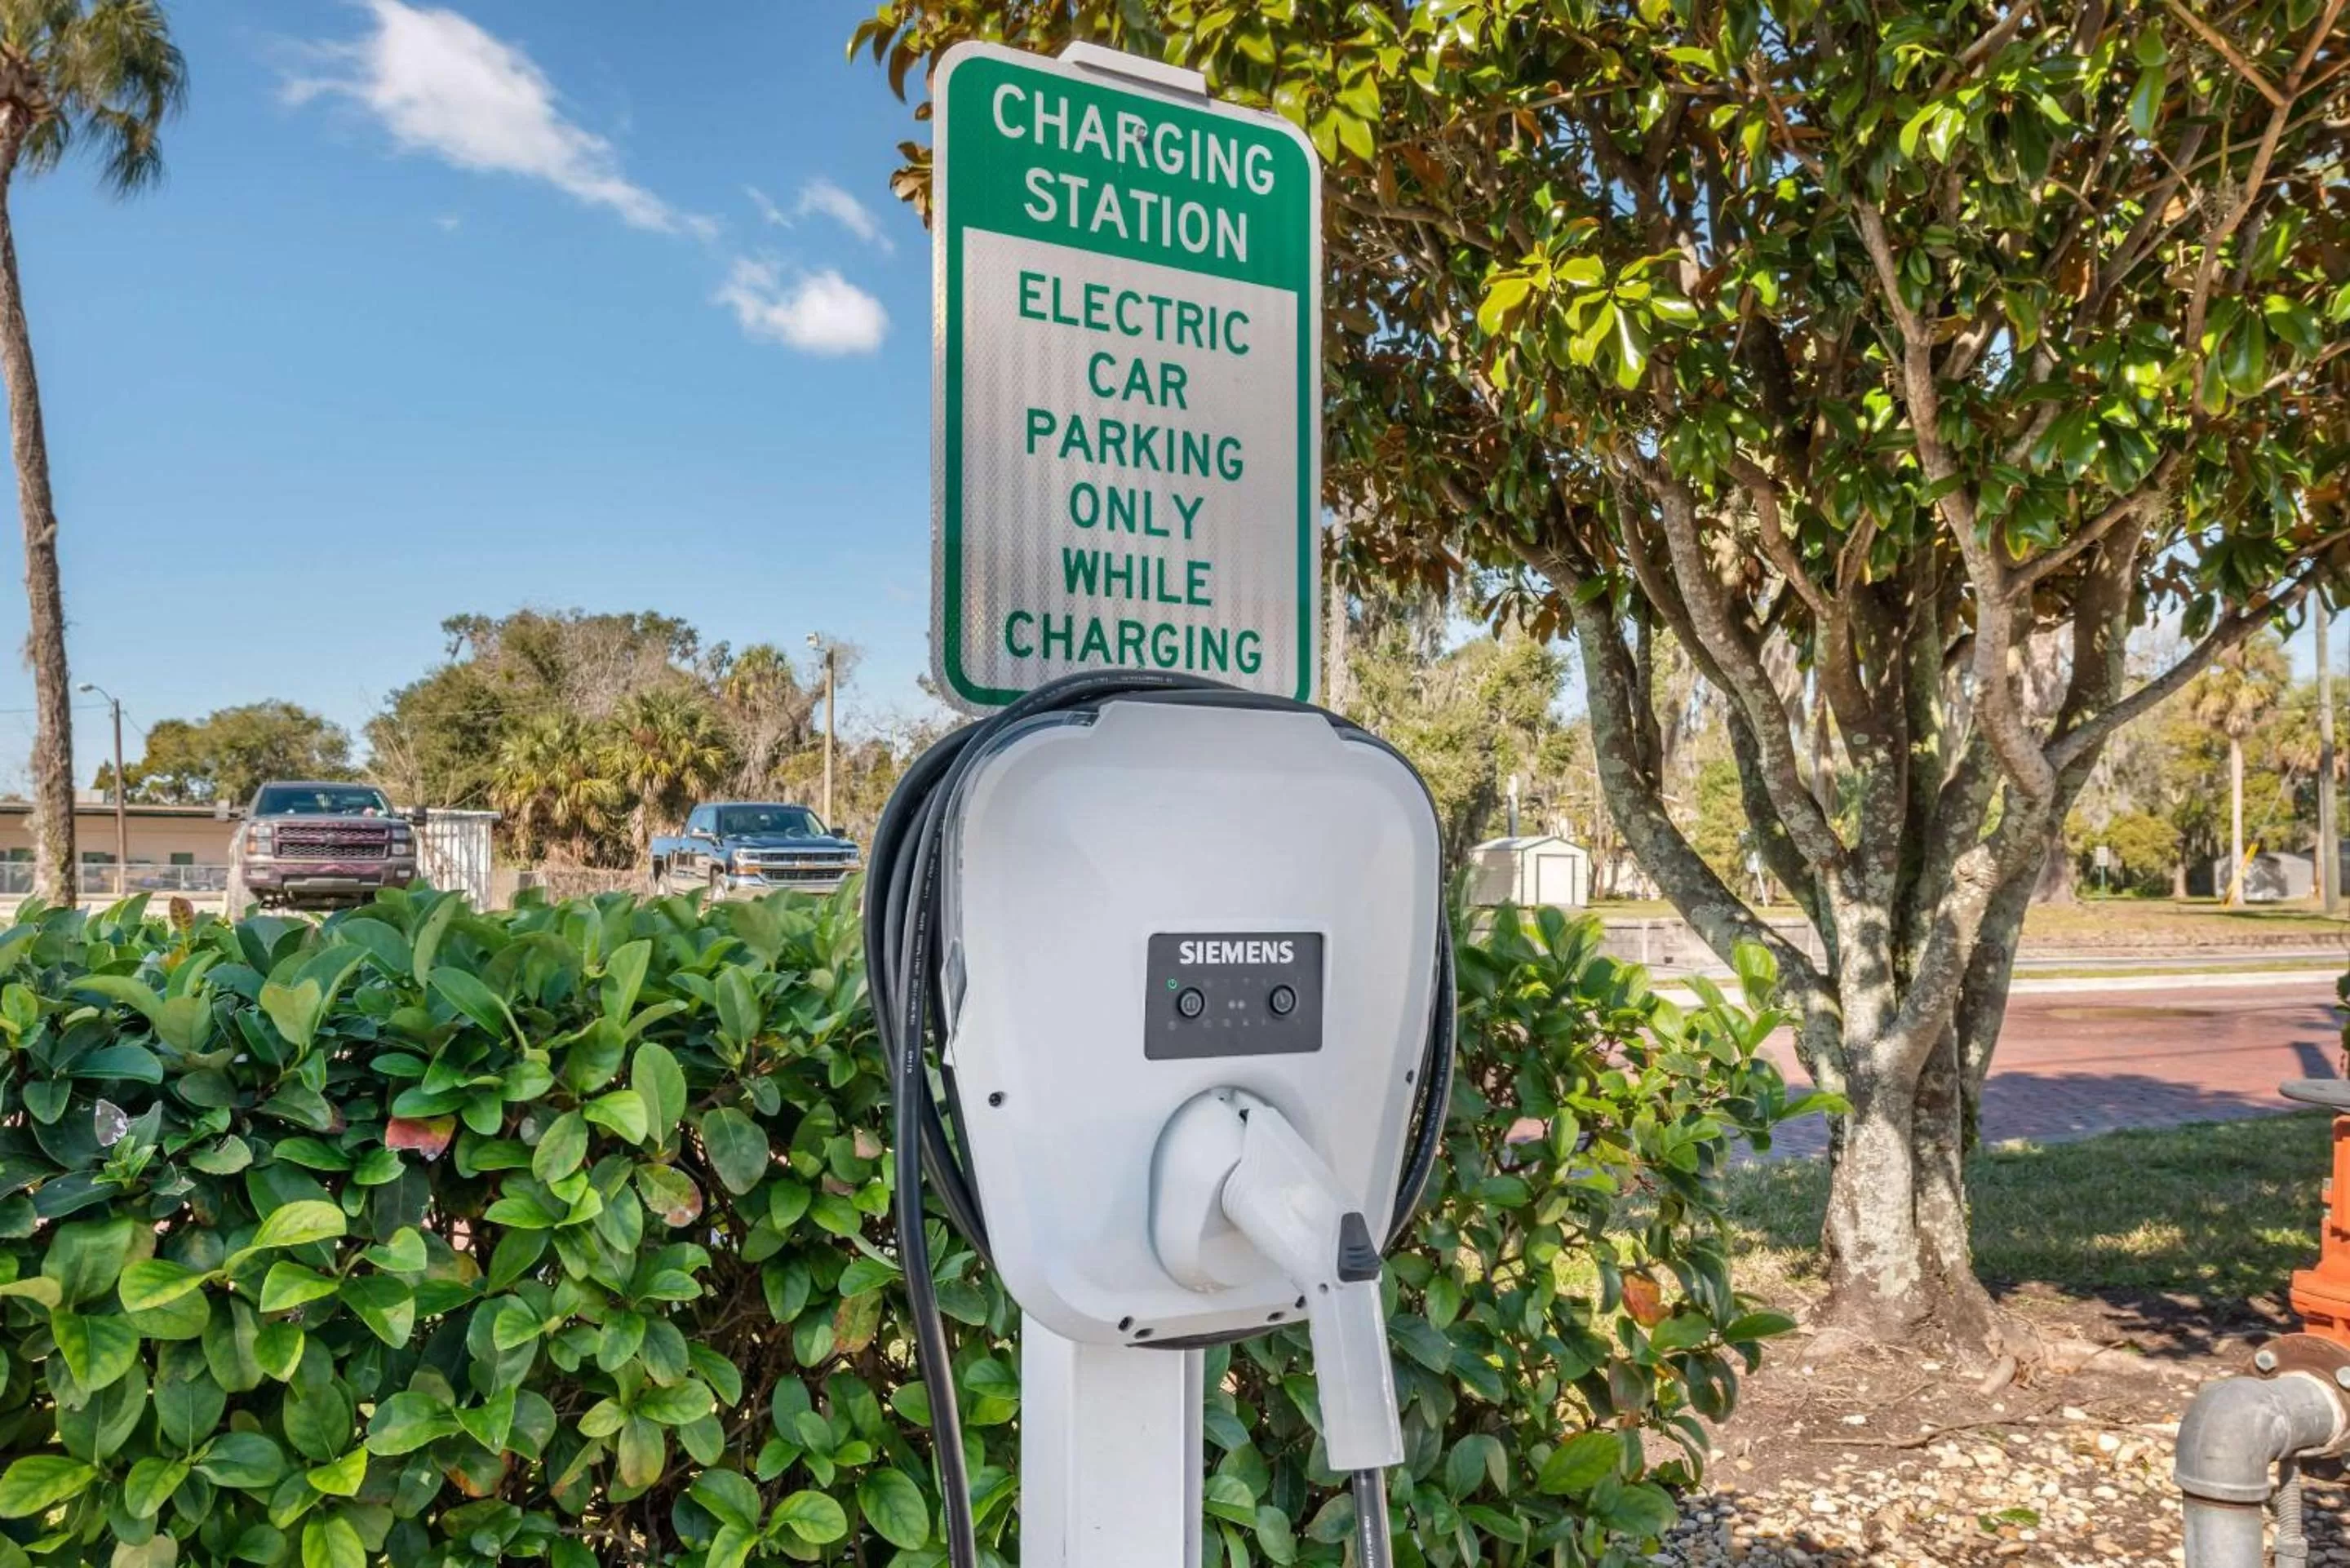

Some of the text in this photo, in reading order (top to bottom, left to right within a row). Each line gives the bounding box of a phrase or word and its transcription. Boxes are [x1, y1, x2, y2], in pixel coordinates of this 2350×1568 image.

[992, 84, 1275, 195] CHARGING
[1024, 167, 1247, 262] STATION
[1019, 270, 1250, 355] ELECTRIC
[1088, 352, 1188, 410] CAR
[1026, 409, 1244, 481] PARKING
[1070, 482, 1204, 539] ONLY
[1062, 547, 1211, 606] WHILE
[1005, 610, 1262, 674] CHARGING
[1179, 941, 1294, 964] SIEMENS
